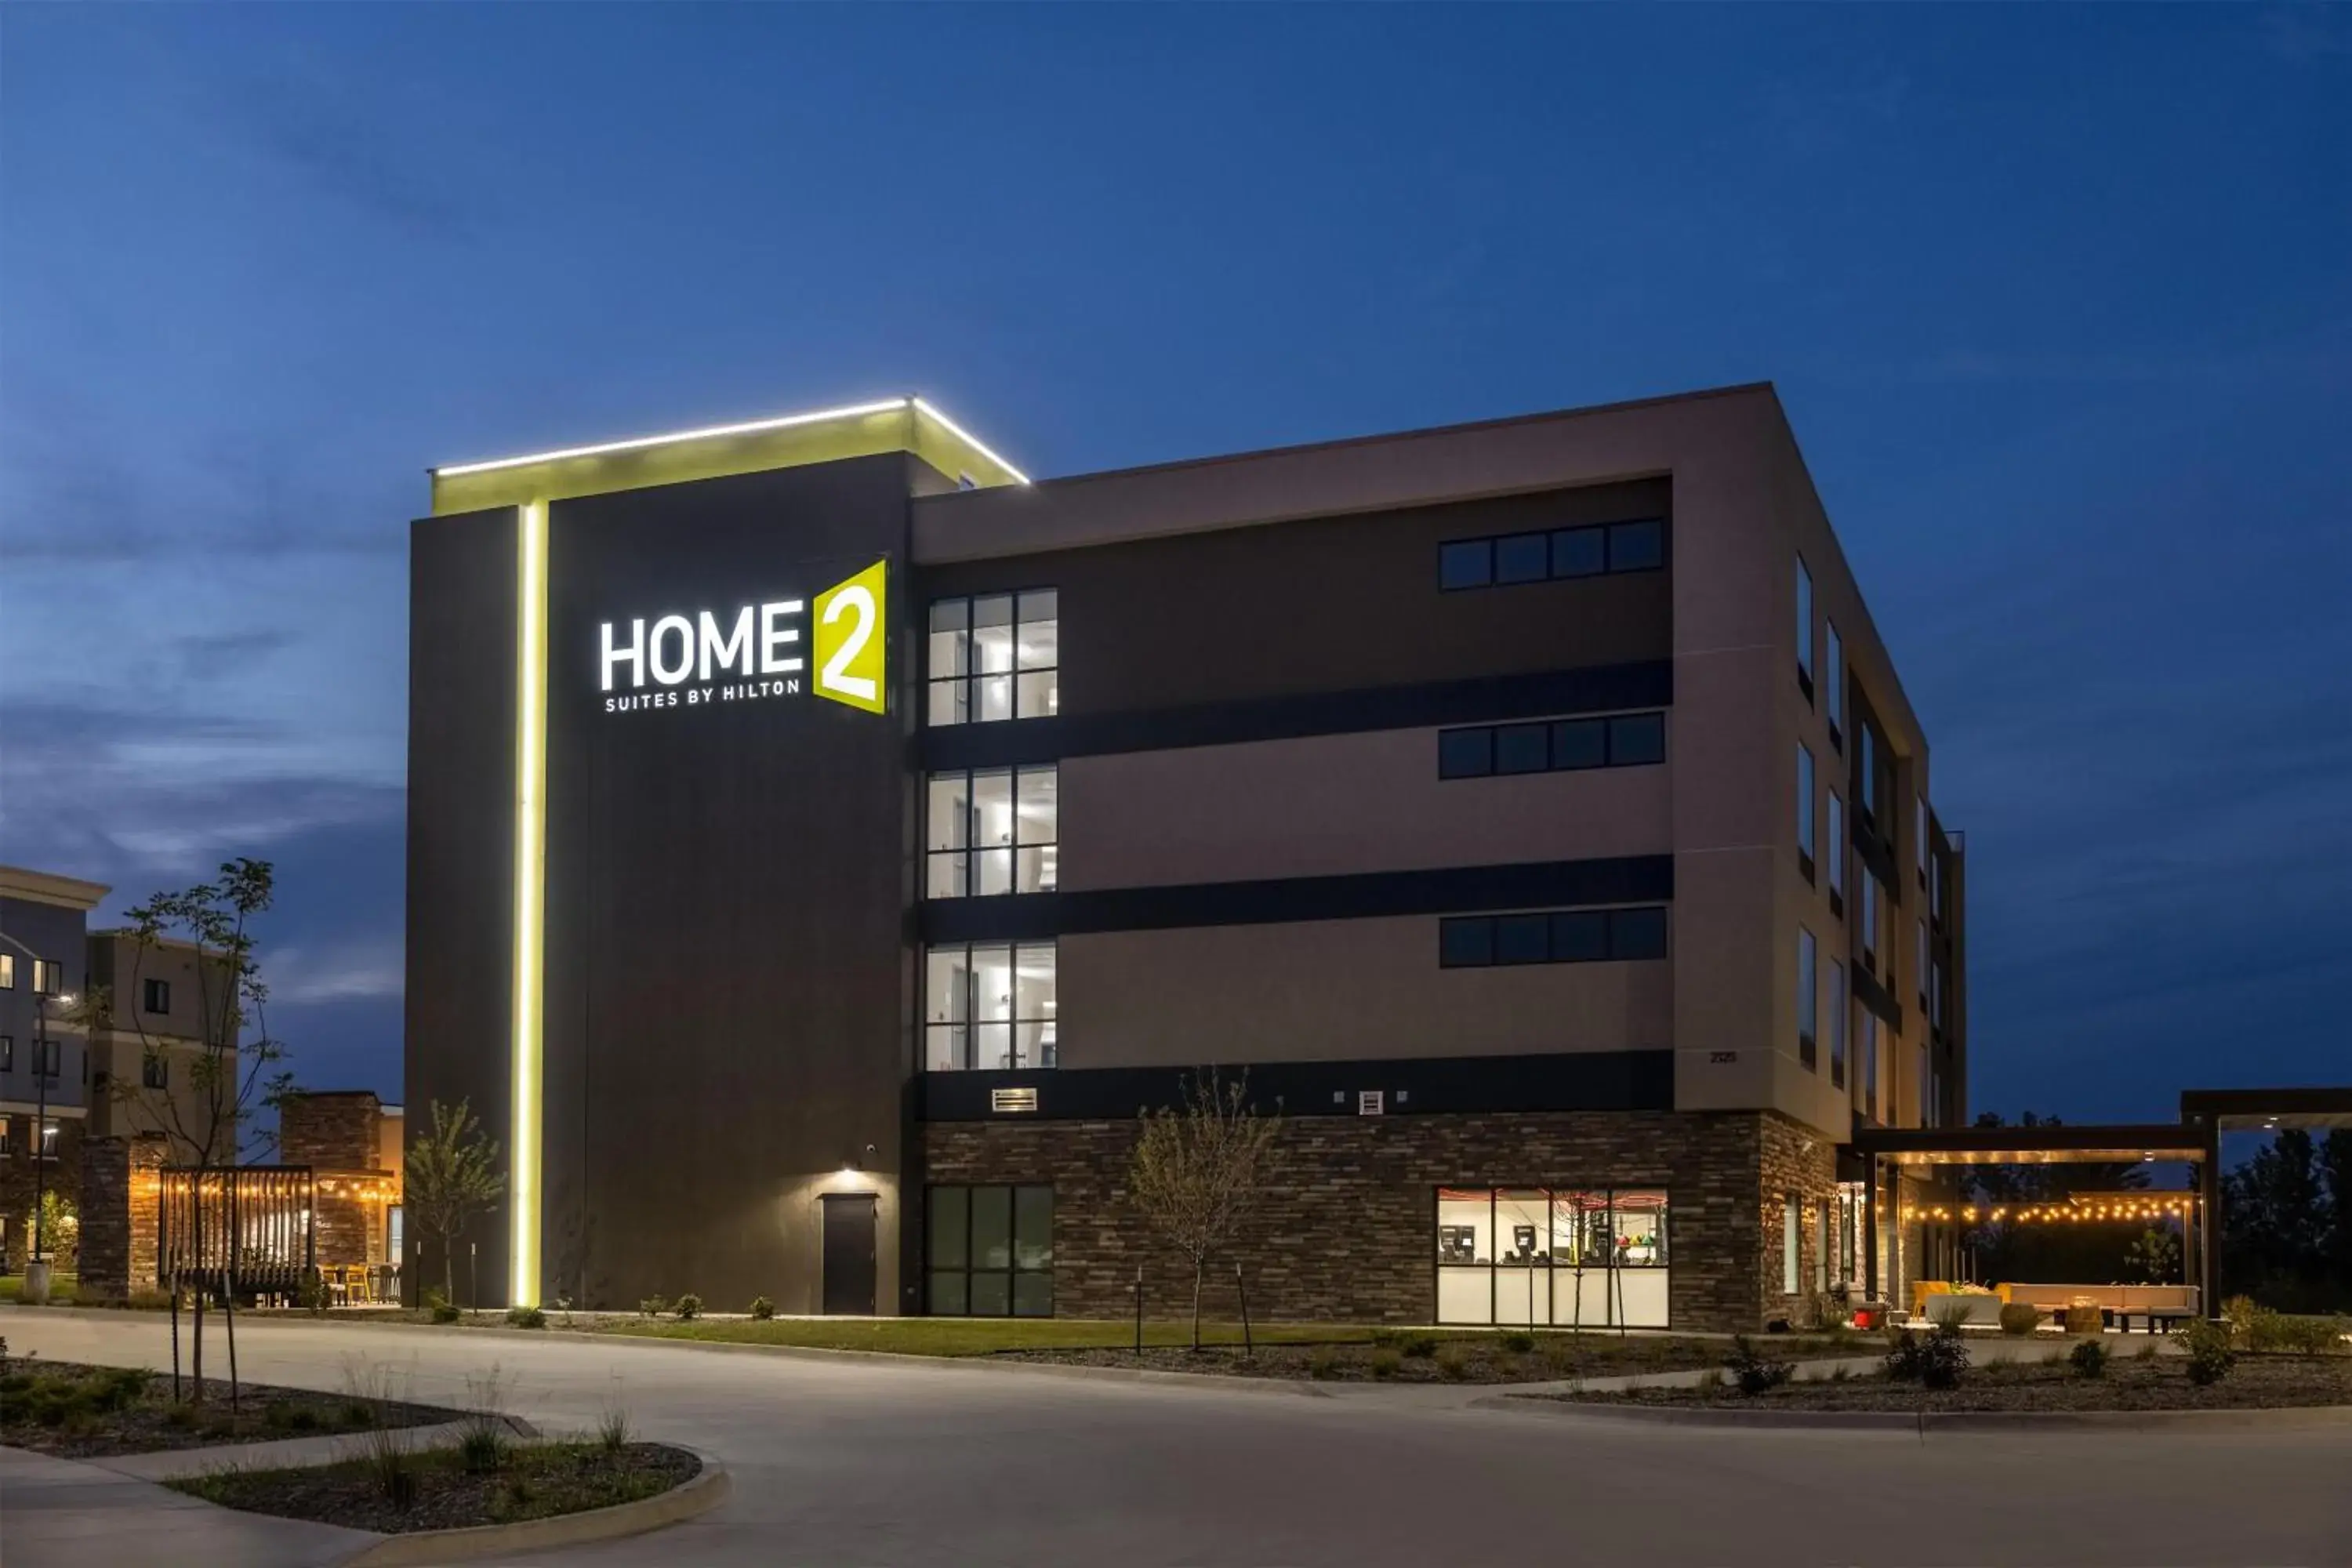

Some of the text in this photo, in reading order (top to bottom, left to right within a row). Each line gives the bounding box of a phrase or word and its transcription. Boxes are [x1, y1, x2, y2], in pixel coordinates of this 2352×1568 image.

[601, 585, 876, 702] HOME 2
[605, 679, 800, 713] SUITES BY HILTON
